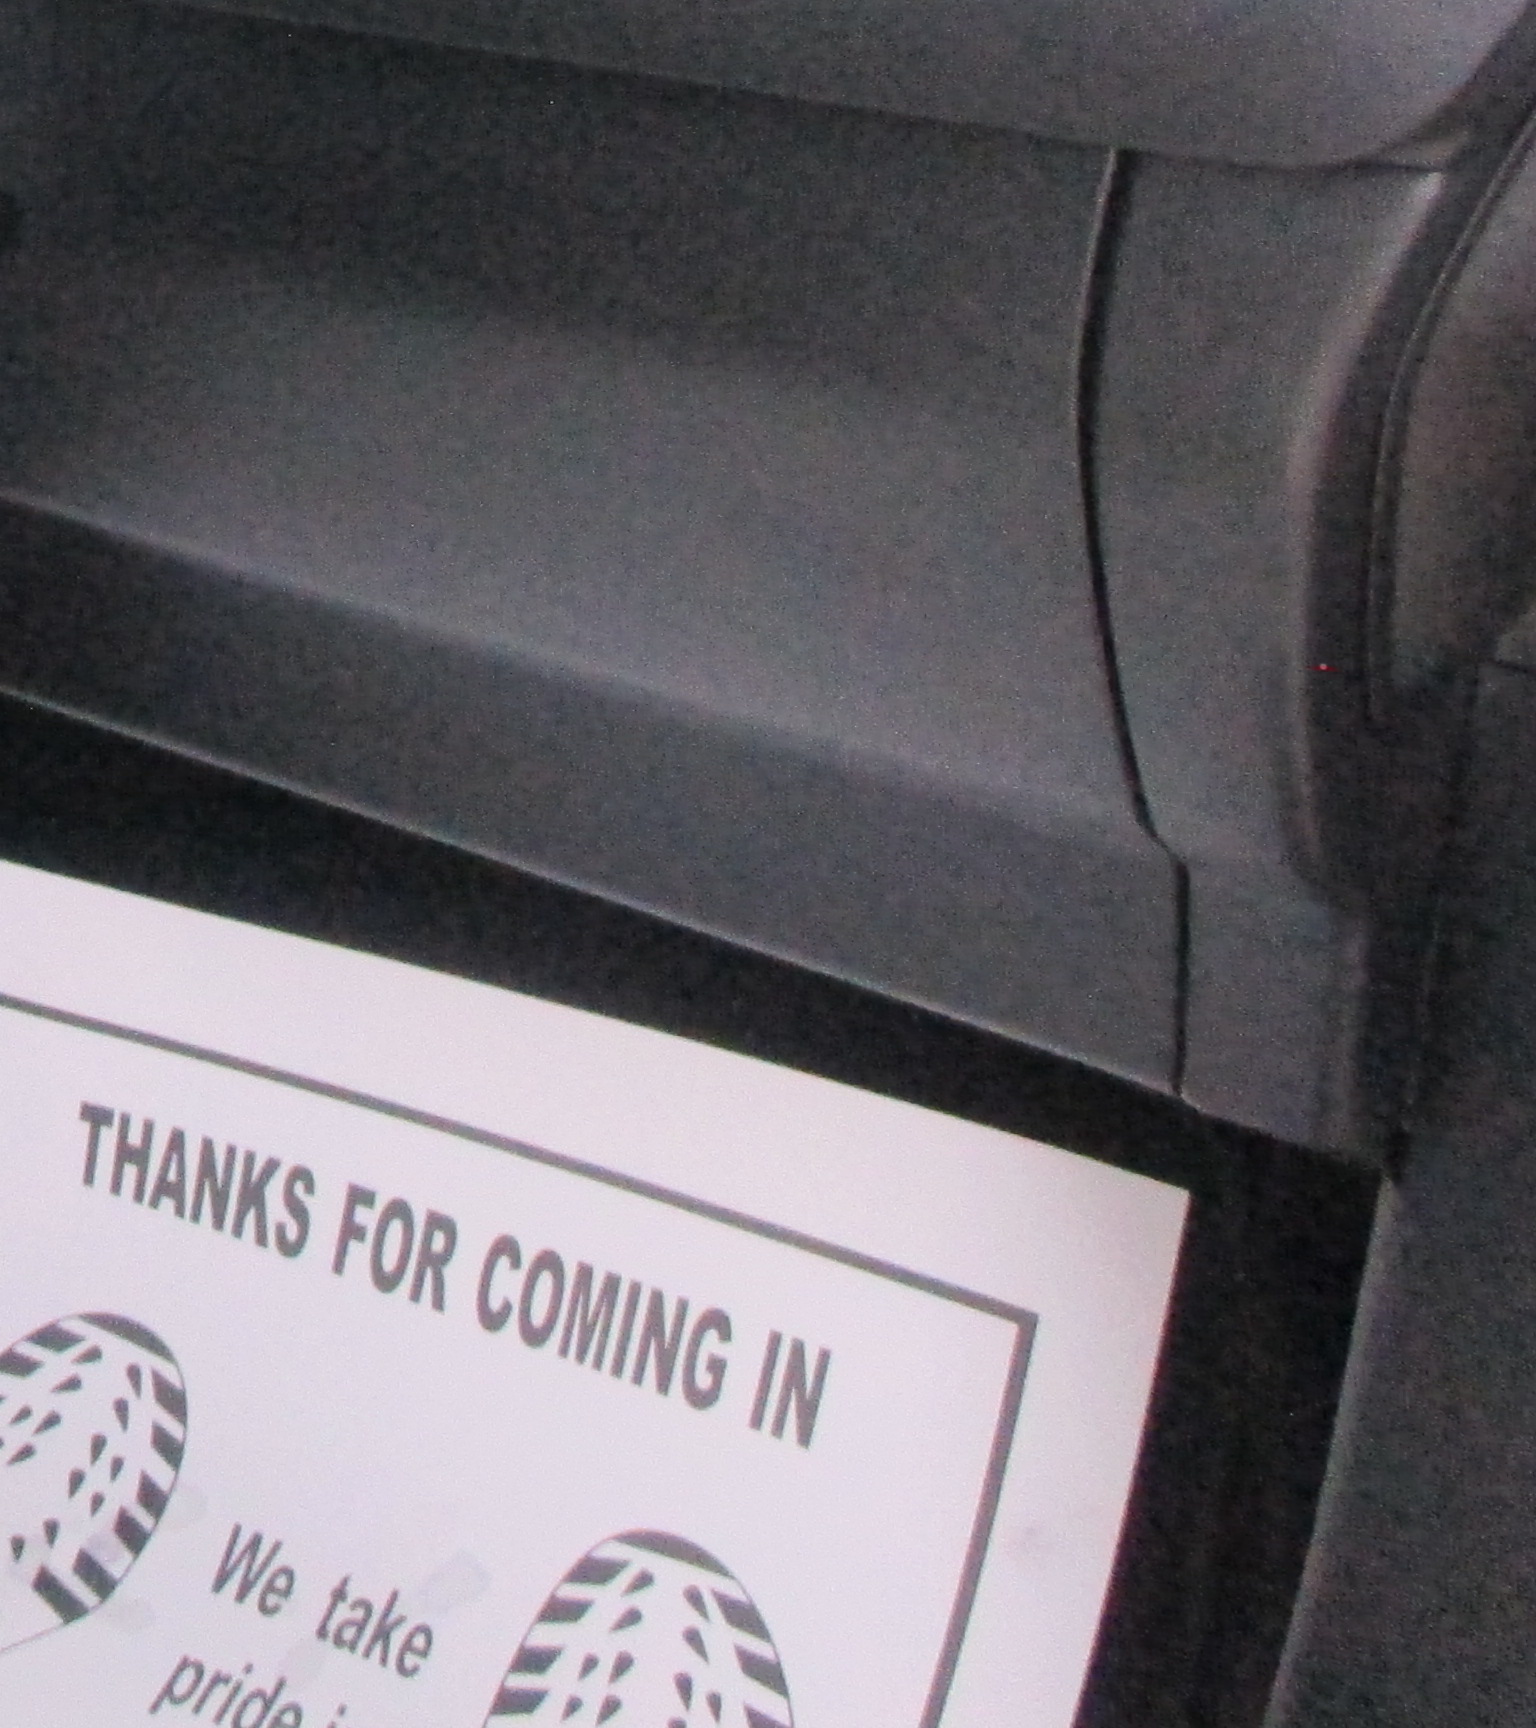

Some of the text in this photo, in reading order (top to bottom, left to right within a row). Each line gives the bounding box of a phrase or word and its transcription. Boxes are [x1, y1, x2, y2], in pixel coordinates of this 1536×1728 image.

[78, 1101, 832, 1449] THANKS FOR COMING IN
[212, 1522, 434, 1678] We take
[149, 1655, 303, 1728] pride
